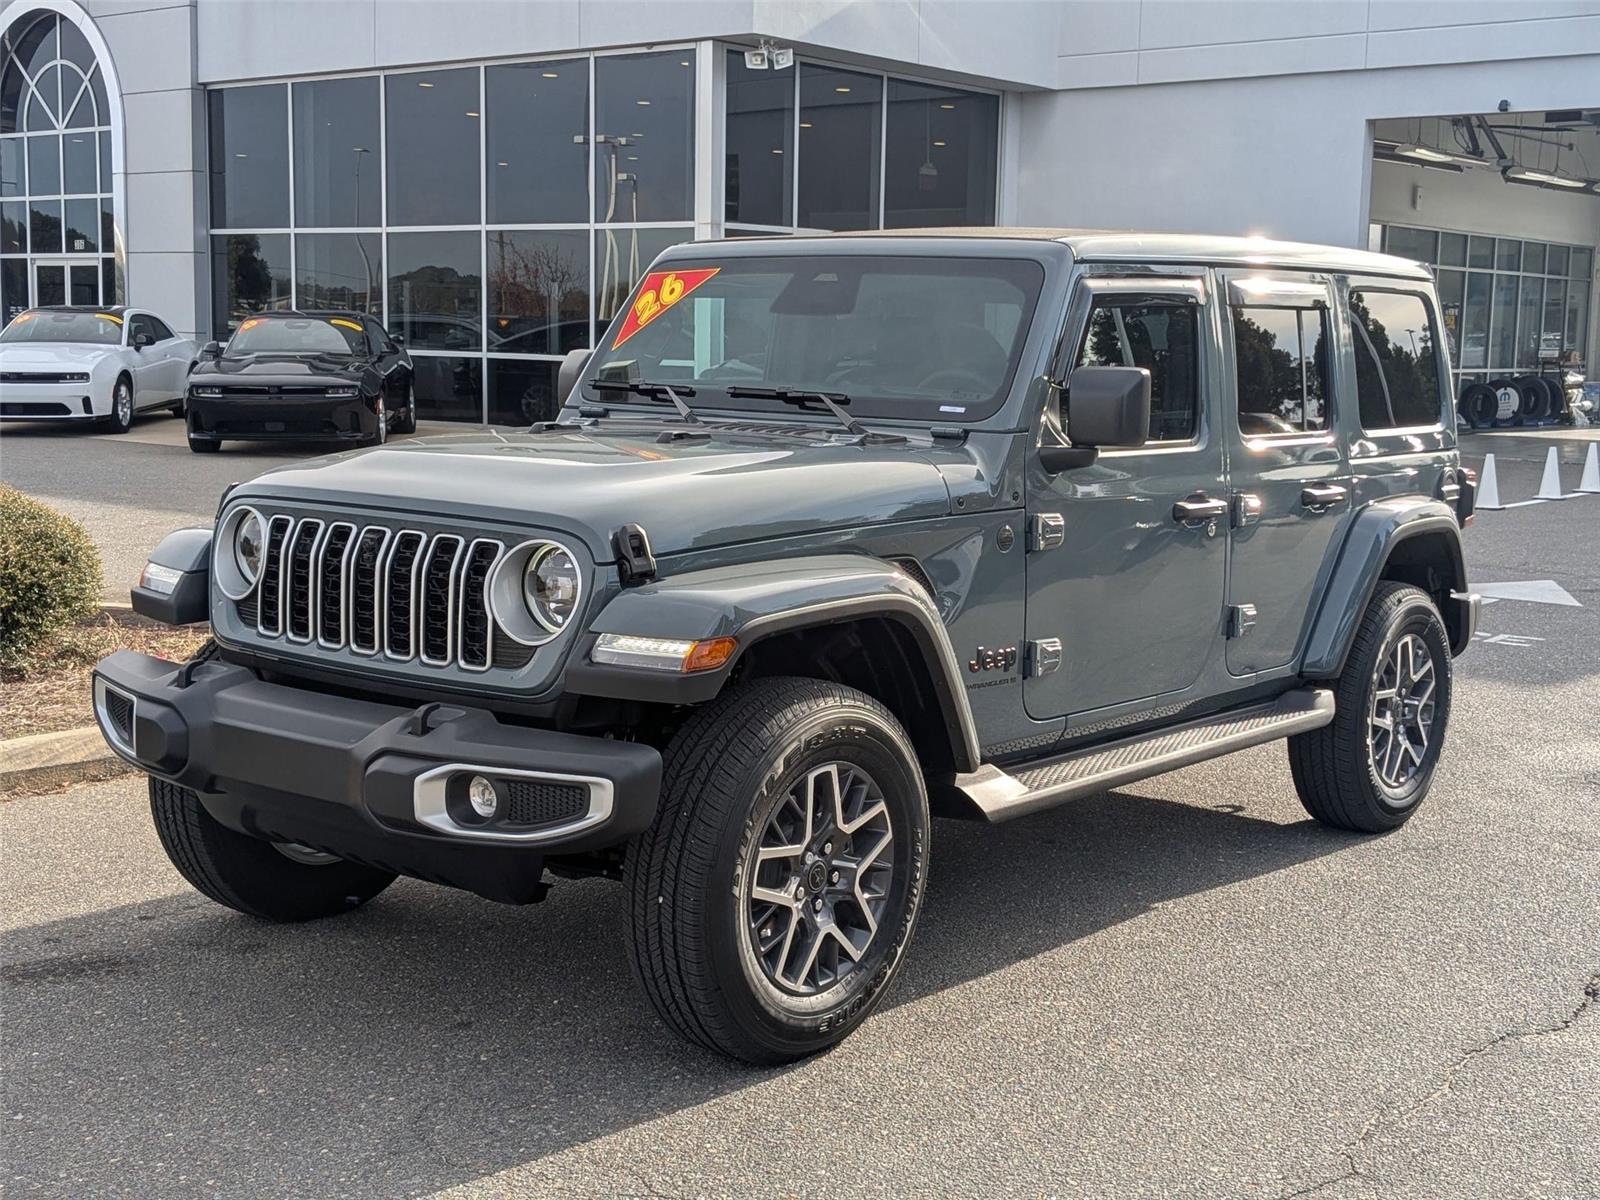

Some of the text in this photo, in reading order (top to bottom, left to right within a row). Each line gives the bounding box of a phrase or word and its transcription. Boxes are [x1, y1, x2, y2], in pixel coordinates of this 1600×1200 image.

[634, 273, 685, 326] 26
[968, 646, 1017, 673] Jeep
[966, 678, 1009, 690] WRANGLER
